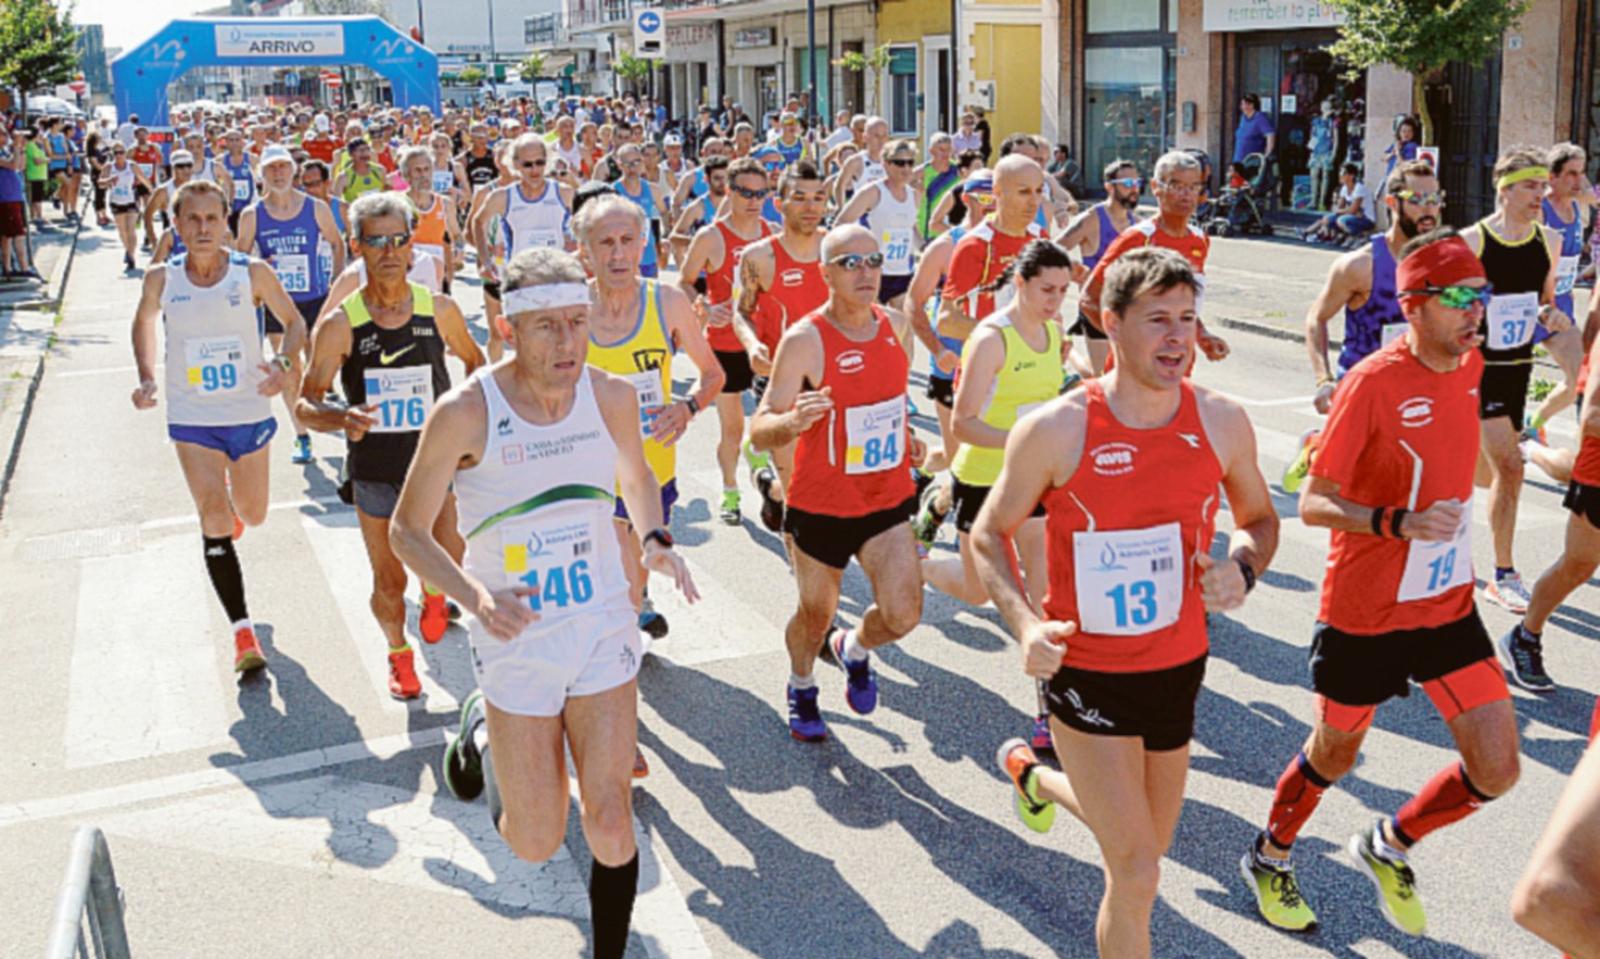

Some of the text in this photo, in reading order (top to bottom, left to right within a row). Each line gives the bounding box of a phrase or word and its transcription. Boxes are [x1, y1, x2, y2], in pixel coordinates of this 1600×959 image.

[249, 40, 315, 53] ARRIVO
[886, 243, 908, 260] 217
[1502, 320, 1527, 345] 37
[201, 363, 237, 391] 99
[378, 397, 425, 428] 176
[863, 432, 897, 468] 84
[1427, 546, 1456, 591] 19
[518, 559, 594, 612] 146
[1105, 579, 1157, 628] 13
